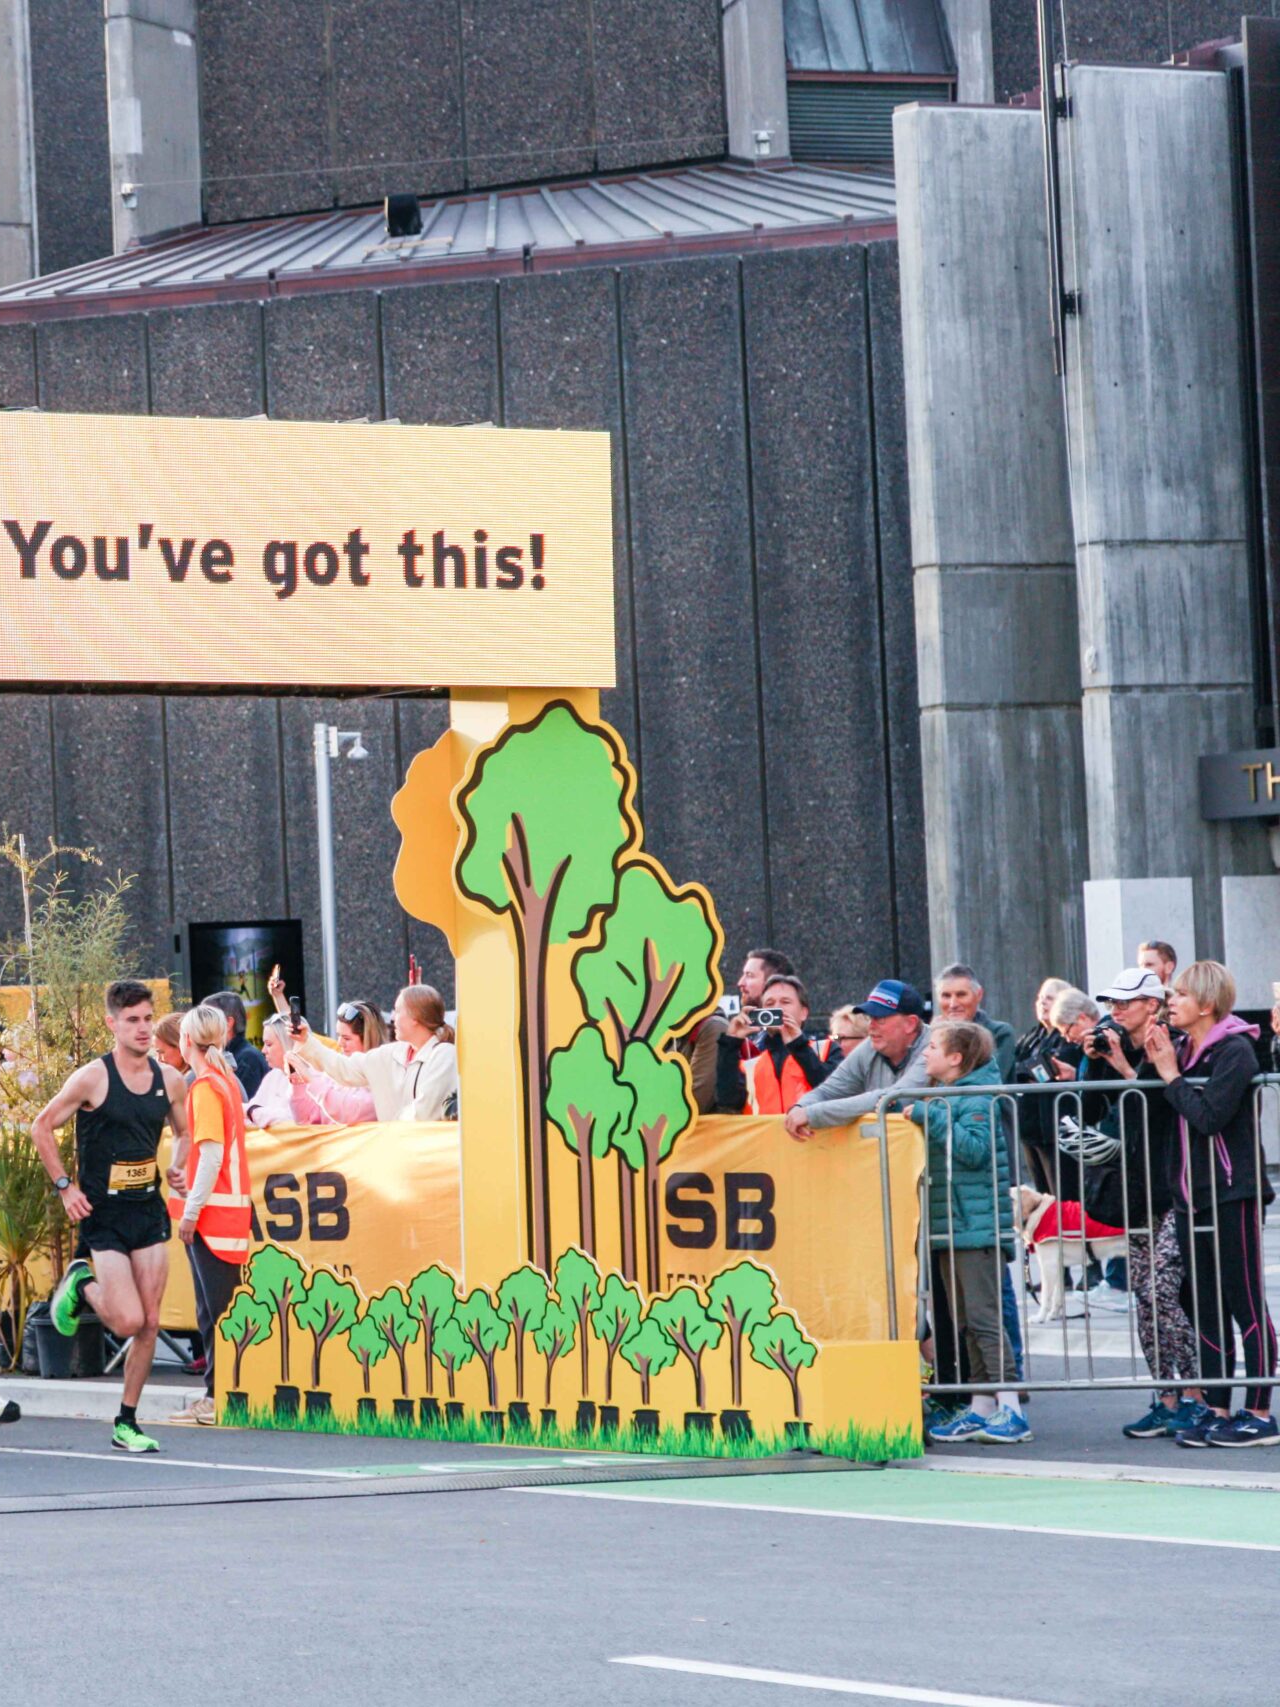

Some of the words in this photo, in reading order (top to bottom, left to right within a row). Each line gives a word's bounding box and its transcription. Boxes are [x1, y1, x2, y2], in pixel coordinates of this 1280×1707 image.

[2, 520, 235, 584] You've
[262, 528, 370, 600] got
[397, 528, 545, 591] this!
[126, 1167, 147, 1177] 1365
